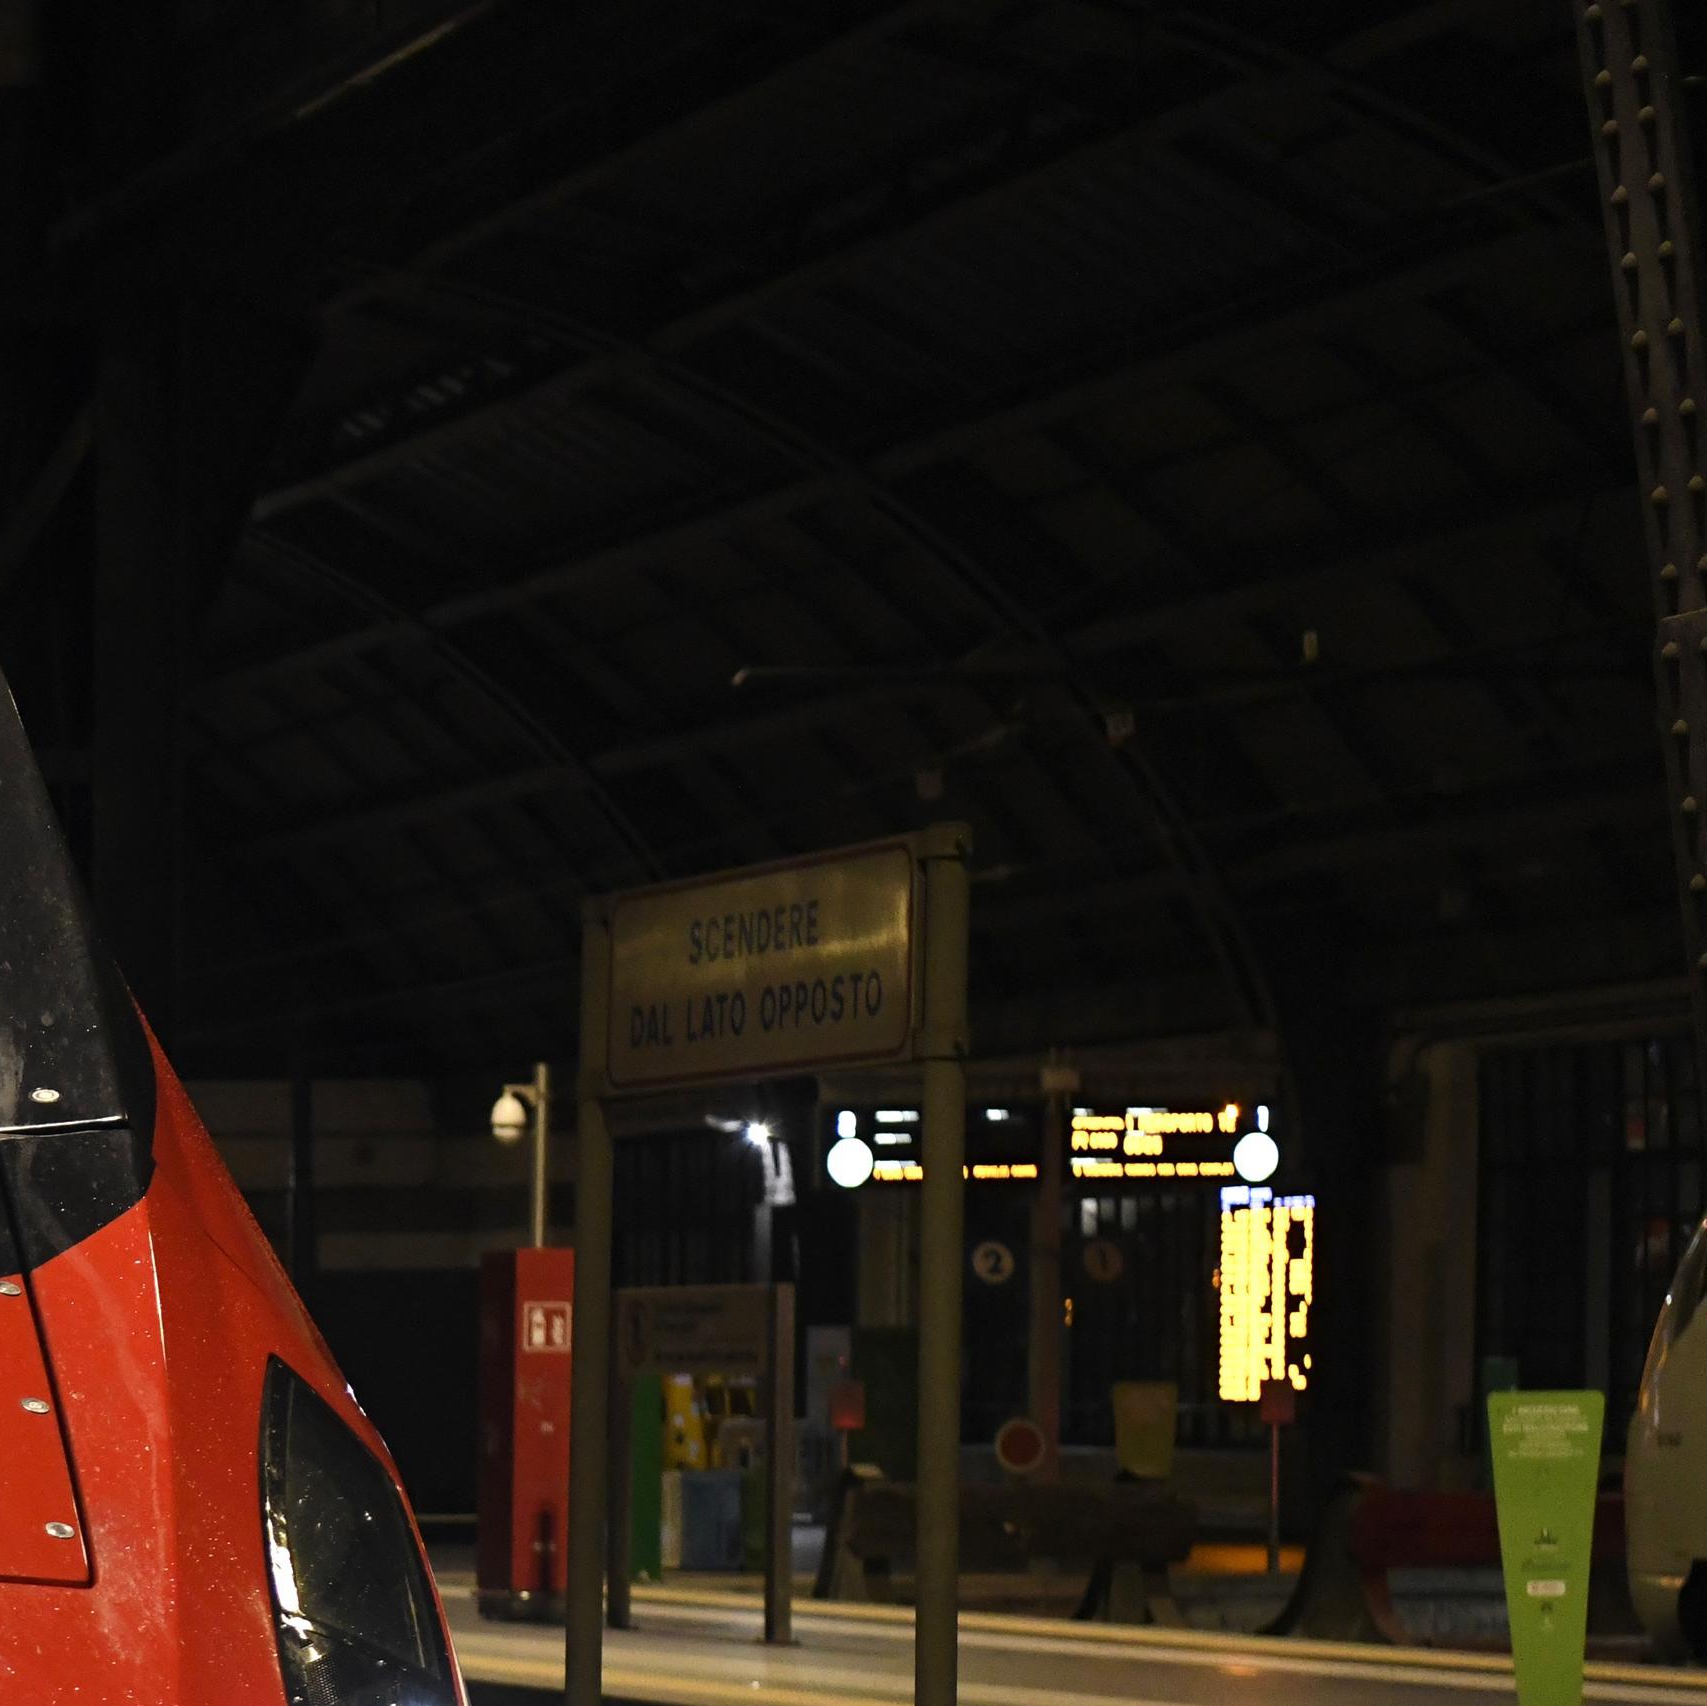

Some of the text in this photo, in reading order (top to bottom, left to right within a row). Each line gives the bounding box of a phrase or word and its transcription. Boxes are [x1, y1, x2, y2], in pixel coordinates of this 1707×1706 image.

[689, 900, 819, 966] SCENDERE
[630, 970, 883, 1048] DAL LATO OPPOSTO
[983, 1247, 1003, 1275] 2
